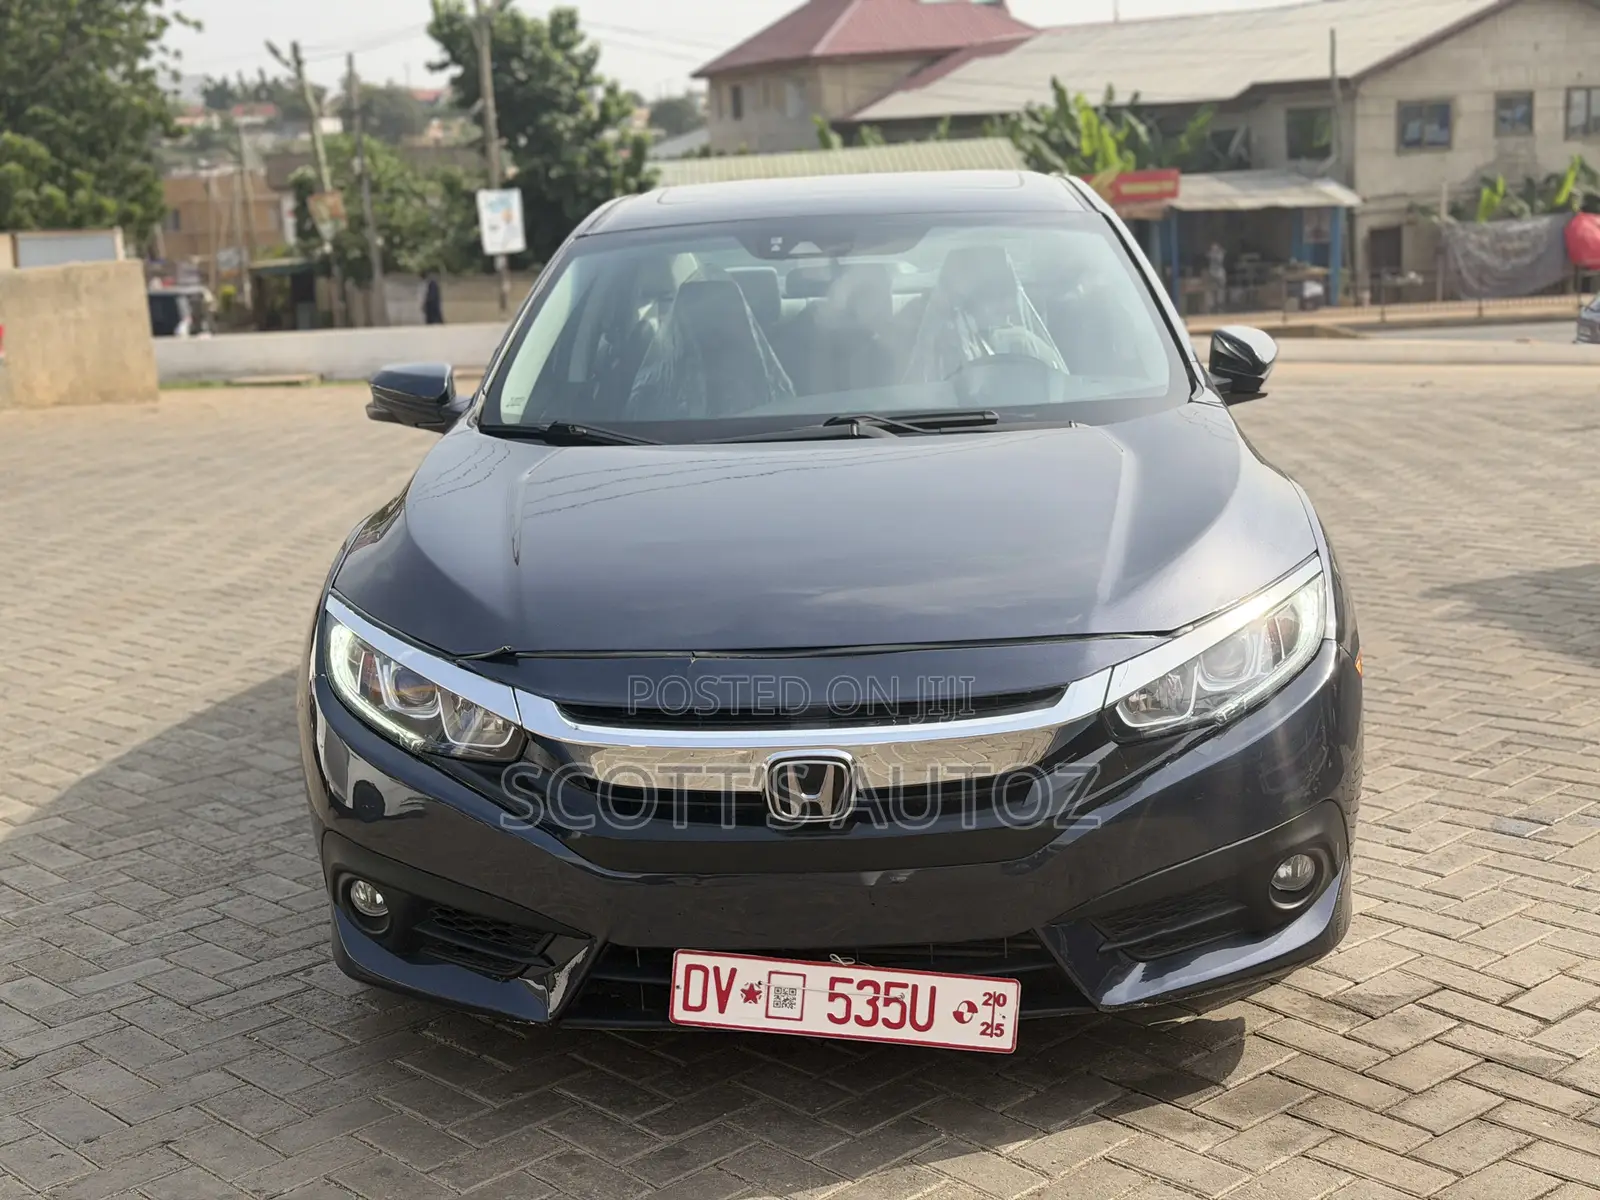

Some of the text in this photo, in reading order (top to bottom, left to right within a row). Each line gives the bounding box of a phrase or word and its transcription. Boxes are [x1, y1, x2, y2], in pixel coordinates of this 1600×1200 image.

[682, 963, 936, 1032] DV 535U
[981, 991, 1007, 1008] 20
[979, 1021, 1005, 1038] 25
